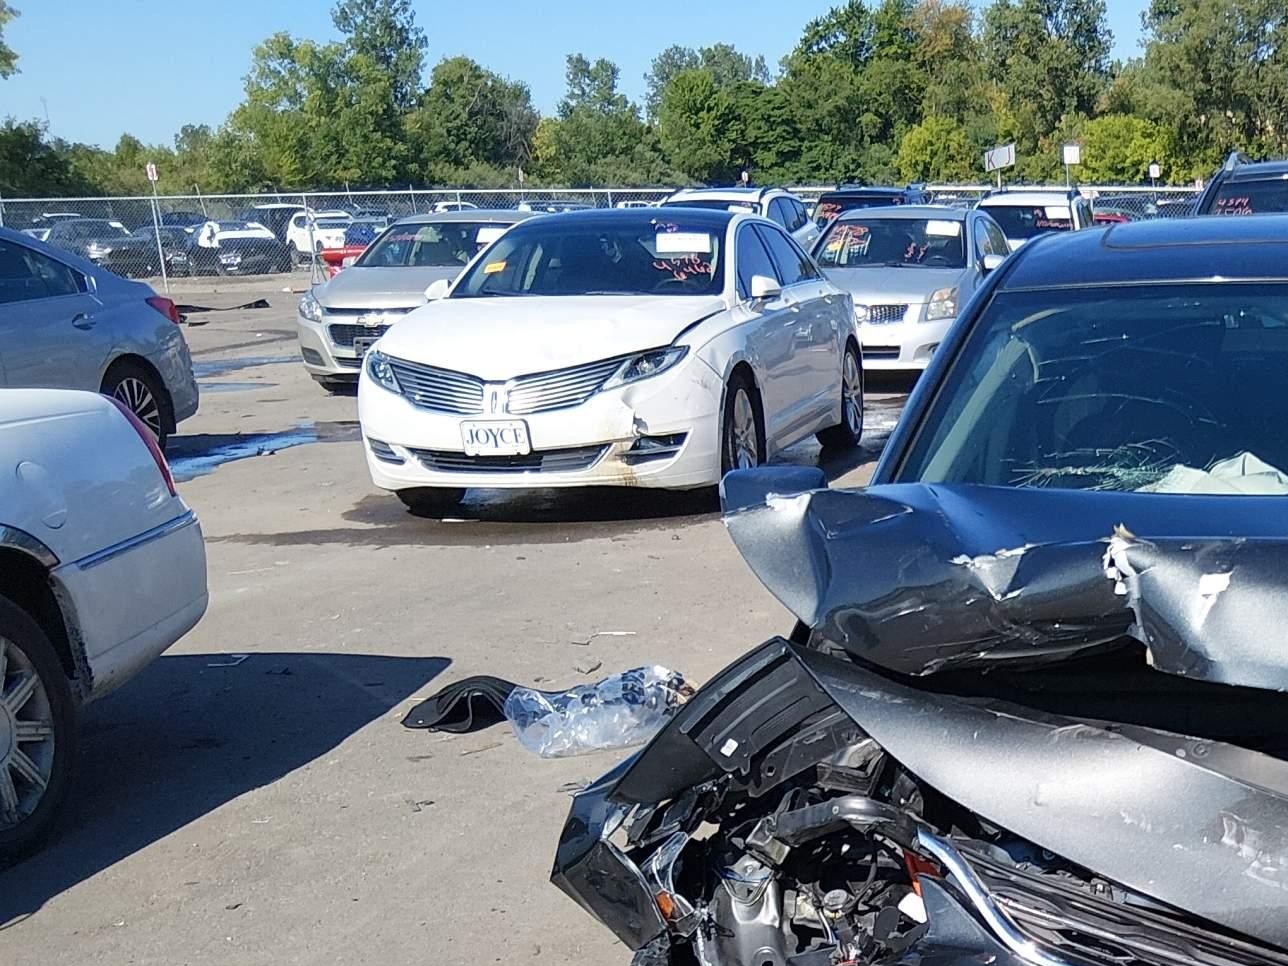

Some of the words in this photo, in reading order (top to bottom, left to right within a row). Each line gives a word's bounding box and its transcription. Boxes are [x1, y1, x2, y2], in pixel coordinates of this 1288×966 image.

[987, 151, 996, 170] K
[1005, 147, 1011, 165] J
[466, 428, 526, 448] JOYCE
